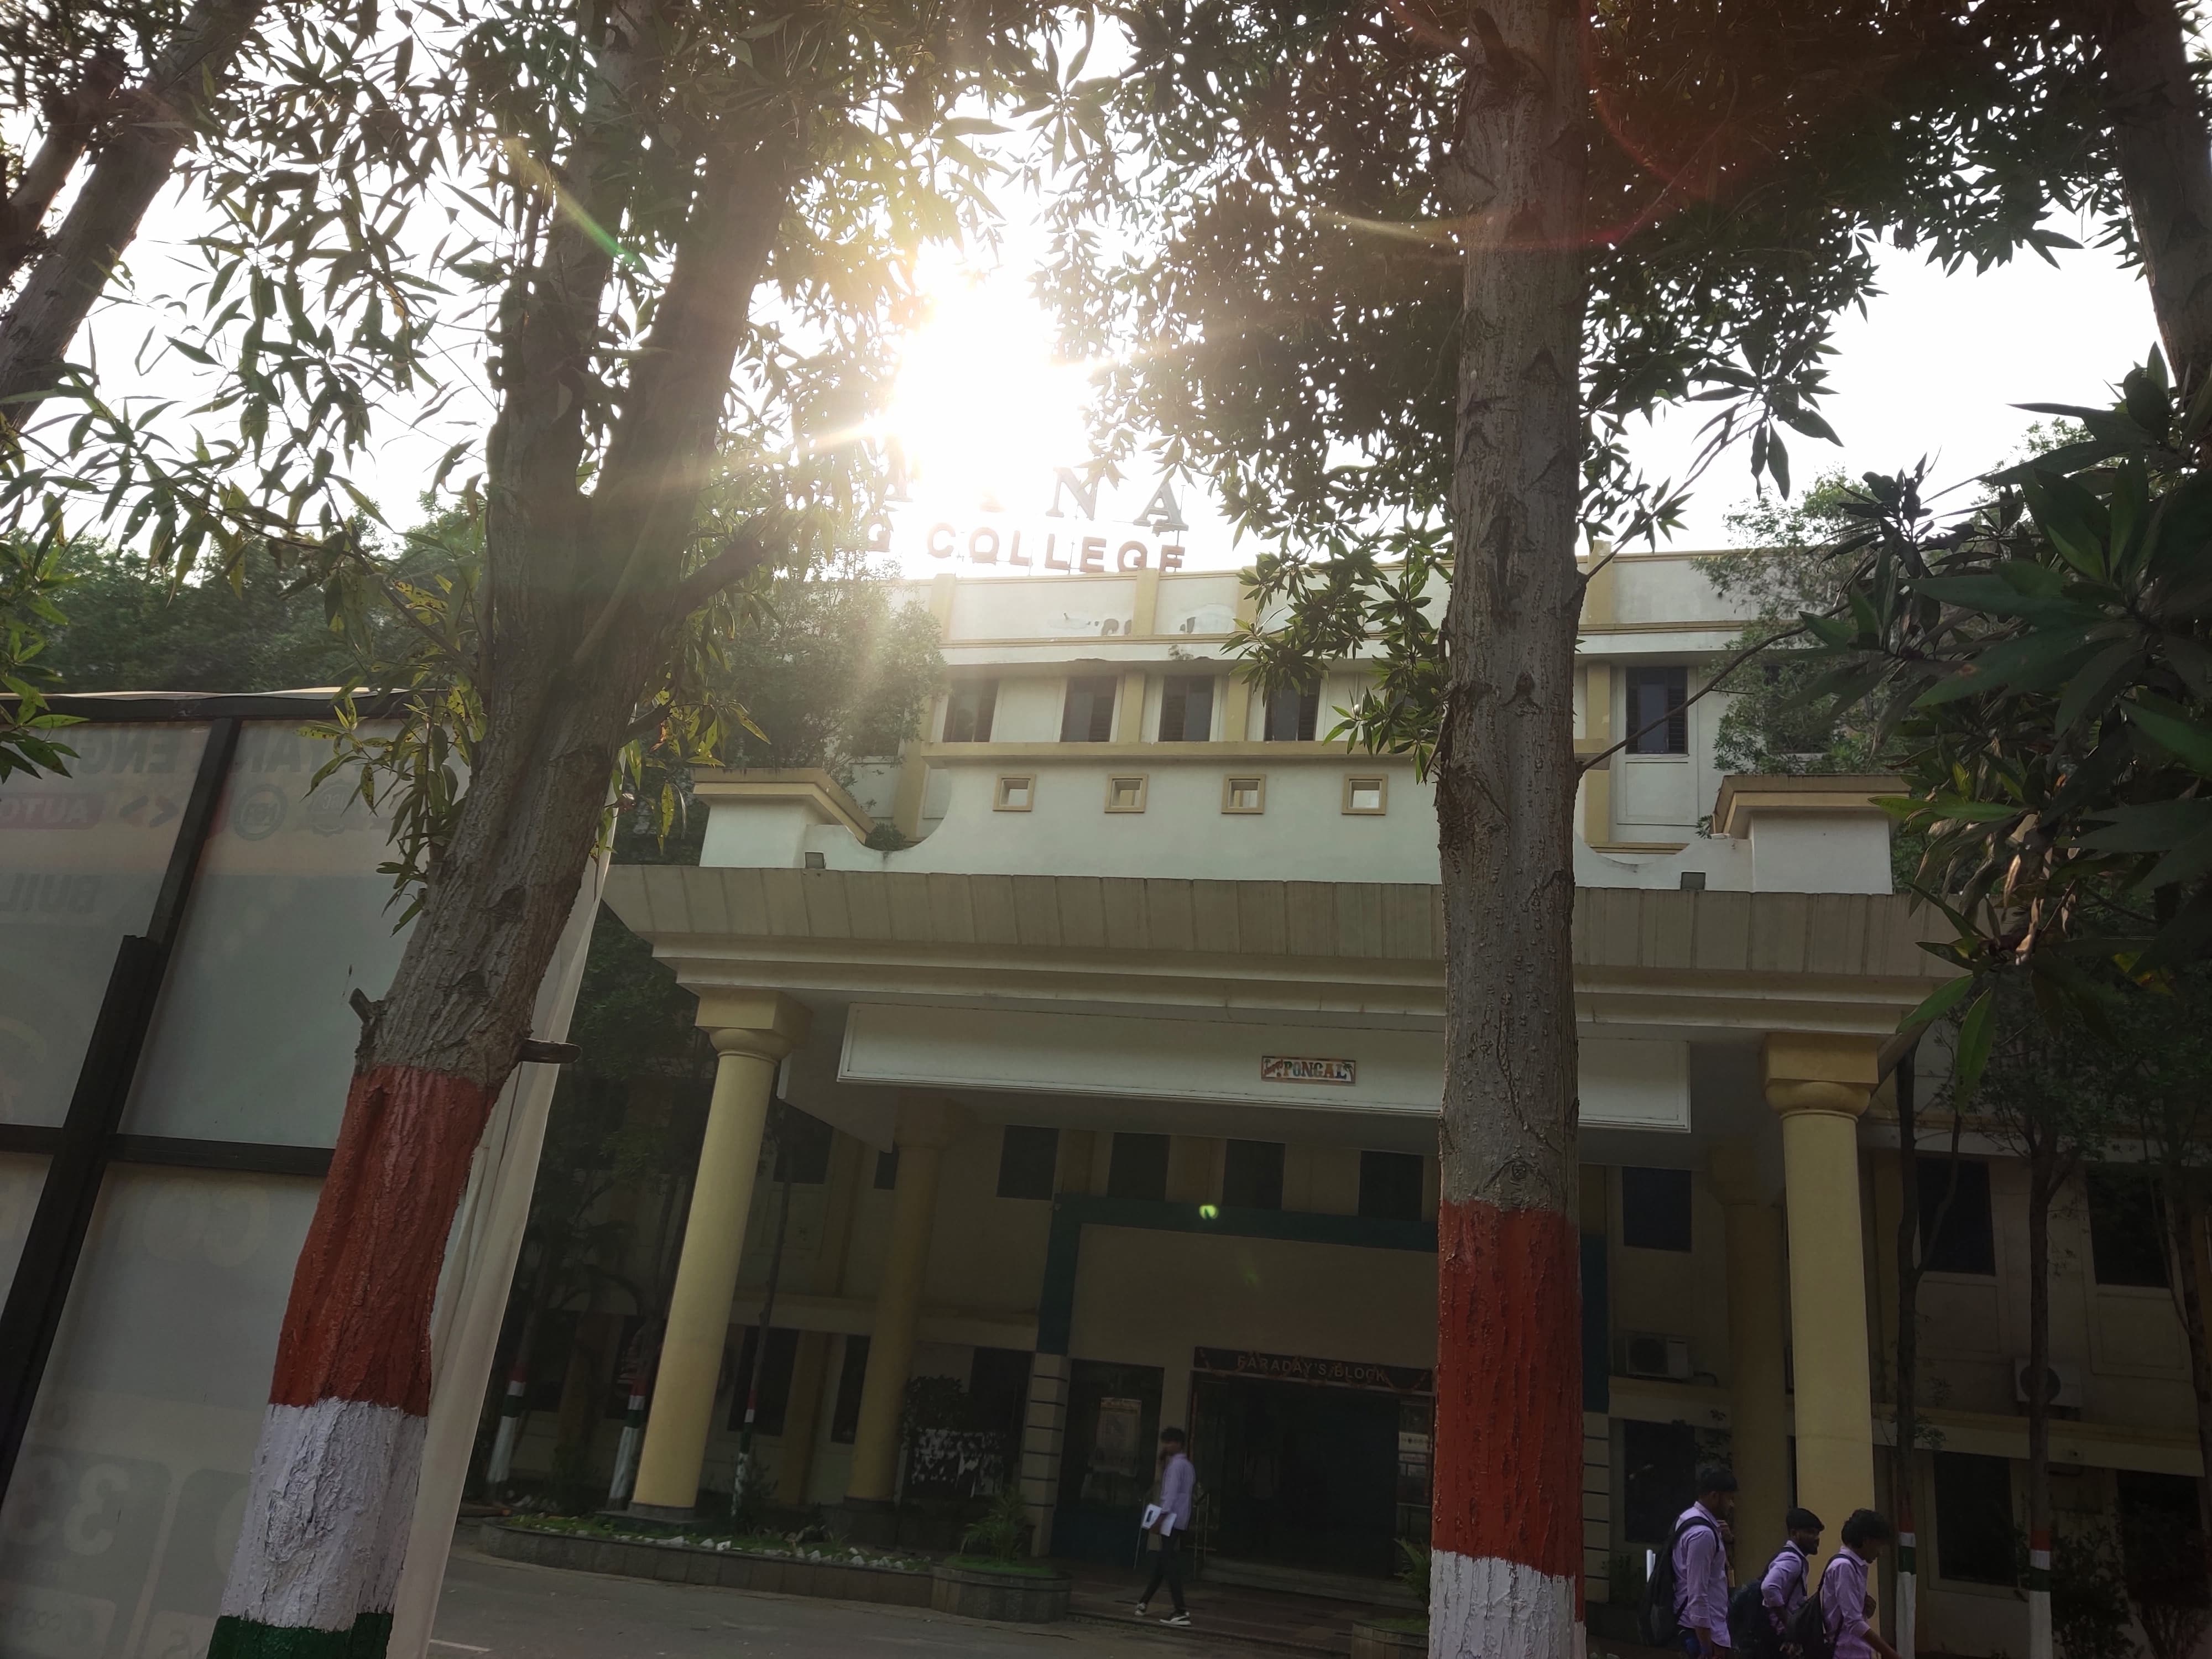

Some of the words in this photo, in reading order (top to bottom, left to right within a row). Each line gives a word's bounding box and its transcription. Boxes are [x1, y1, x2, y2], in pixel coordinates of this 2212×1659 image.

[927, 522, 1185, 572] COLLEGE
[1284, 1061, 1347, 1080] PONGAL
[1237, 1355, 1327, 1376] FARADAY'S
[1334, 1364, 1385, 1381] BLOCK
